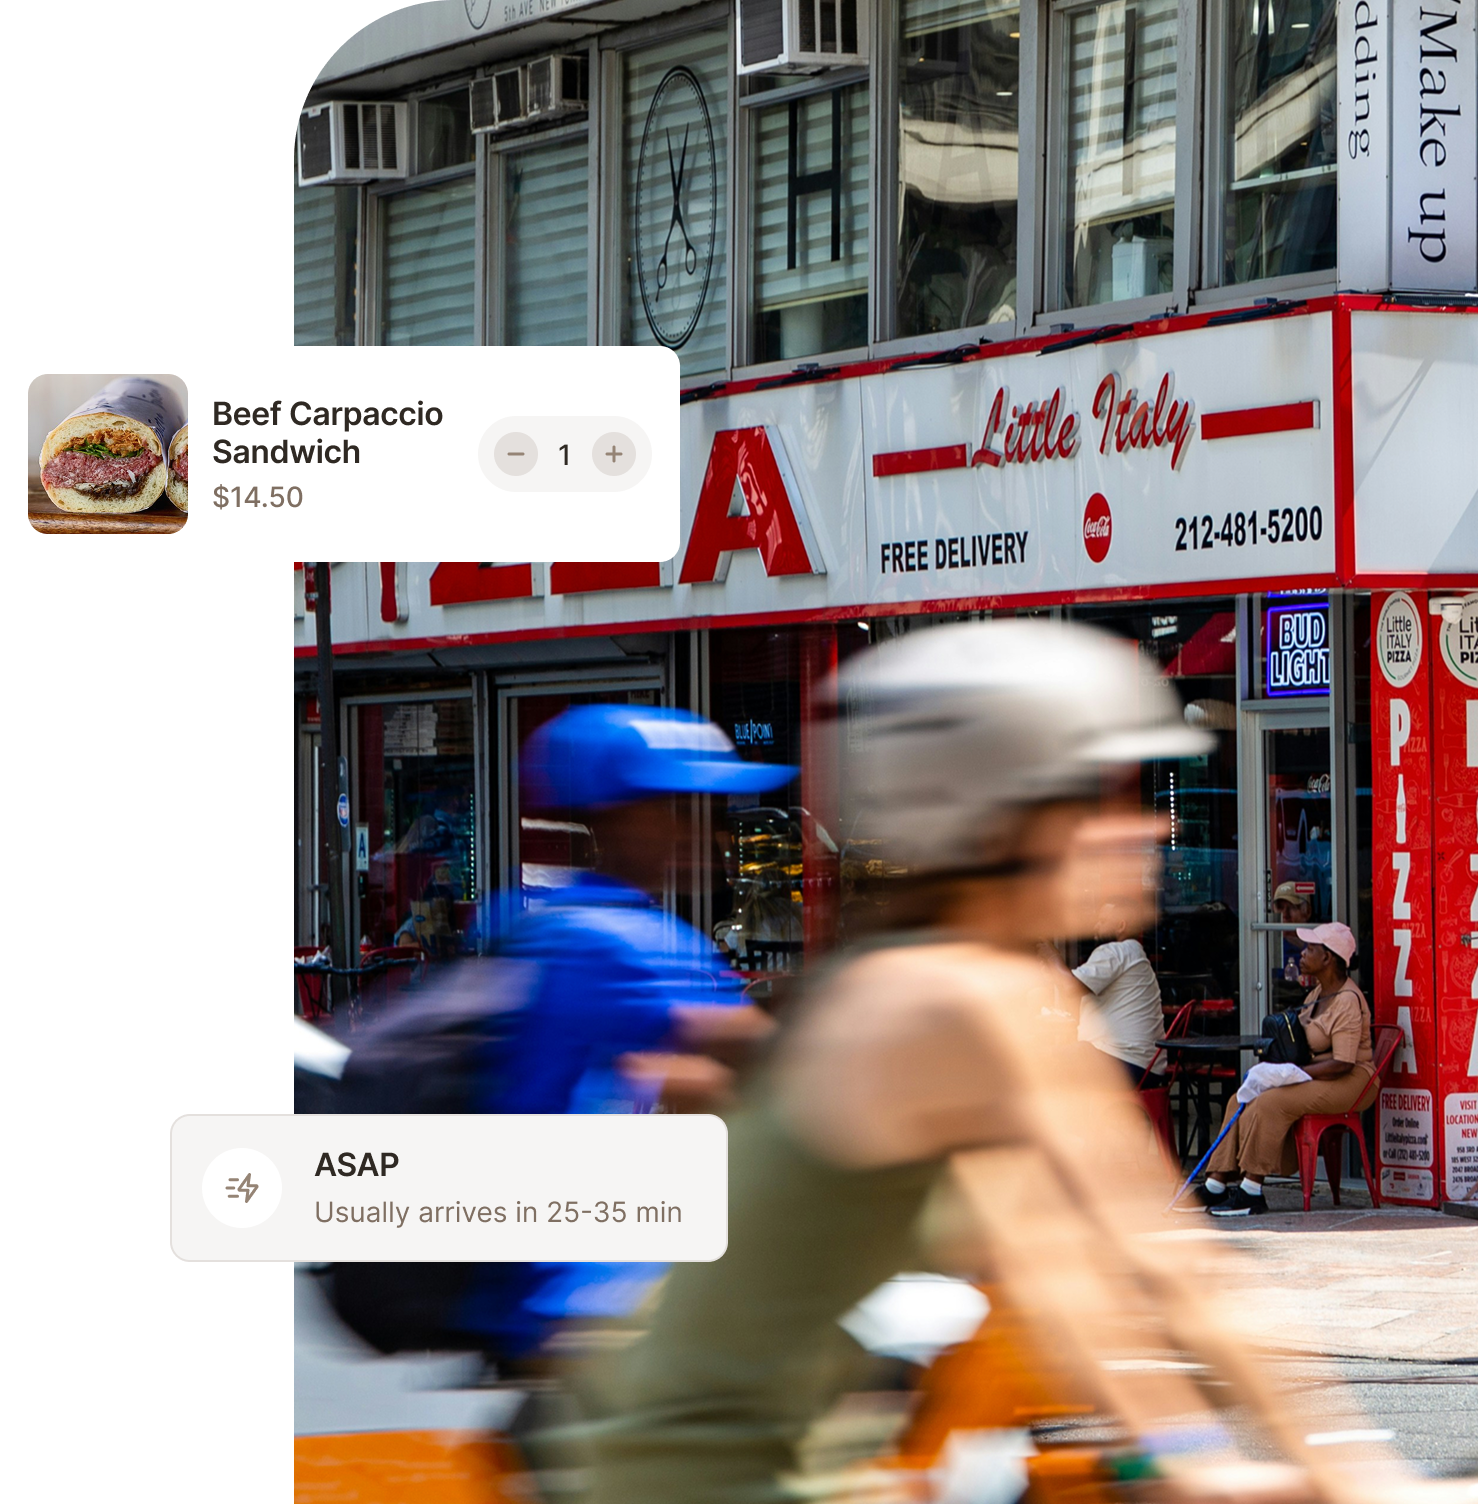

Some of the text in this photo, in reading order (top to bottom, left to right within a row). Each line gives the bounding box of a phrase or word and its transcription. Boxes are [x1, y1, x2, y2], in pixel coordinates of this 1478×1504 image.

[1408, 188, 1447, 263] up
[971, 371, 1196, 472] Little Italy
[1174, 506, 1322, 551] 212-481-5200
[880, 531, 1028, 574] FREE DELIVERY
[1279, 612, 1326, 650] BUD
[1386, 615, 1412, 633] Little
[1386, 633, 1412, 649] ITALY
[1270, 648, 1331, 687] LIGHT
[1387, 651, 1412, 663] PIZZA
[1382, 1093, 1430, 1112] FREE DELIVERY
[1460, 1100, 1477, 1110] VISIT
[1461, 1128, 1478, 1139] NEW
